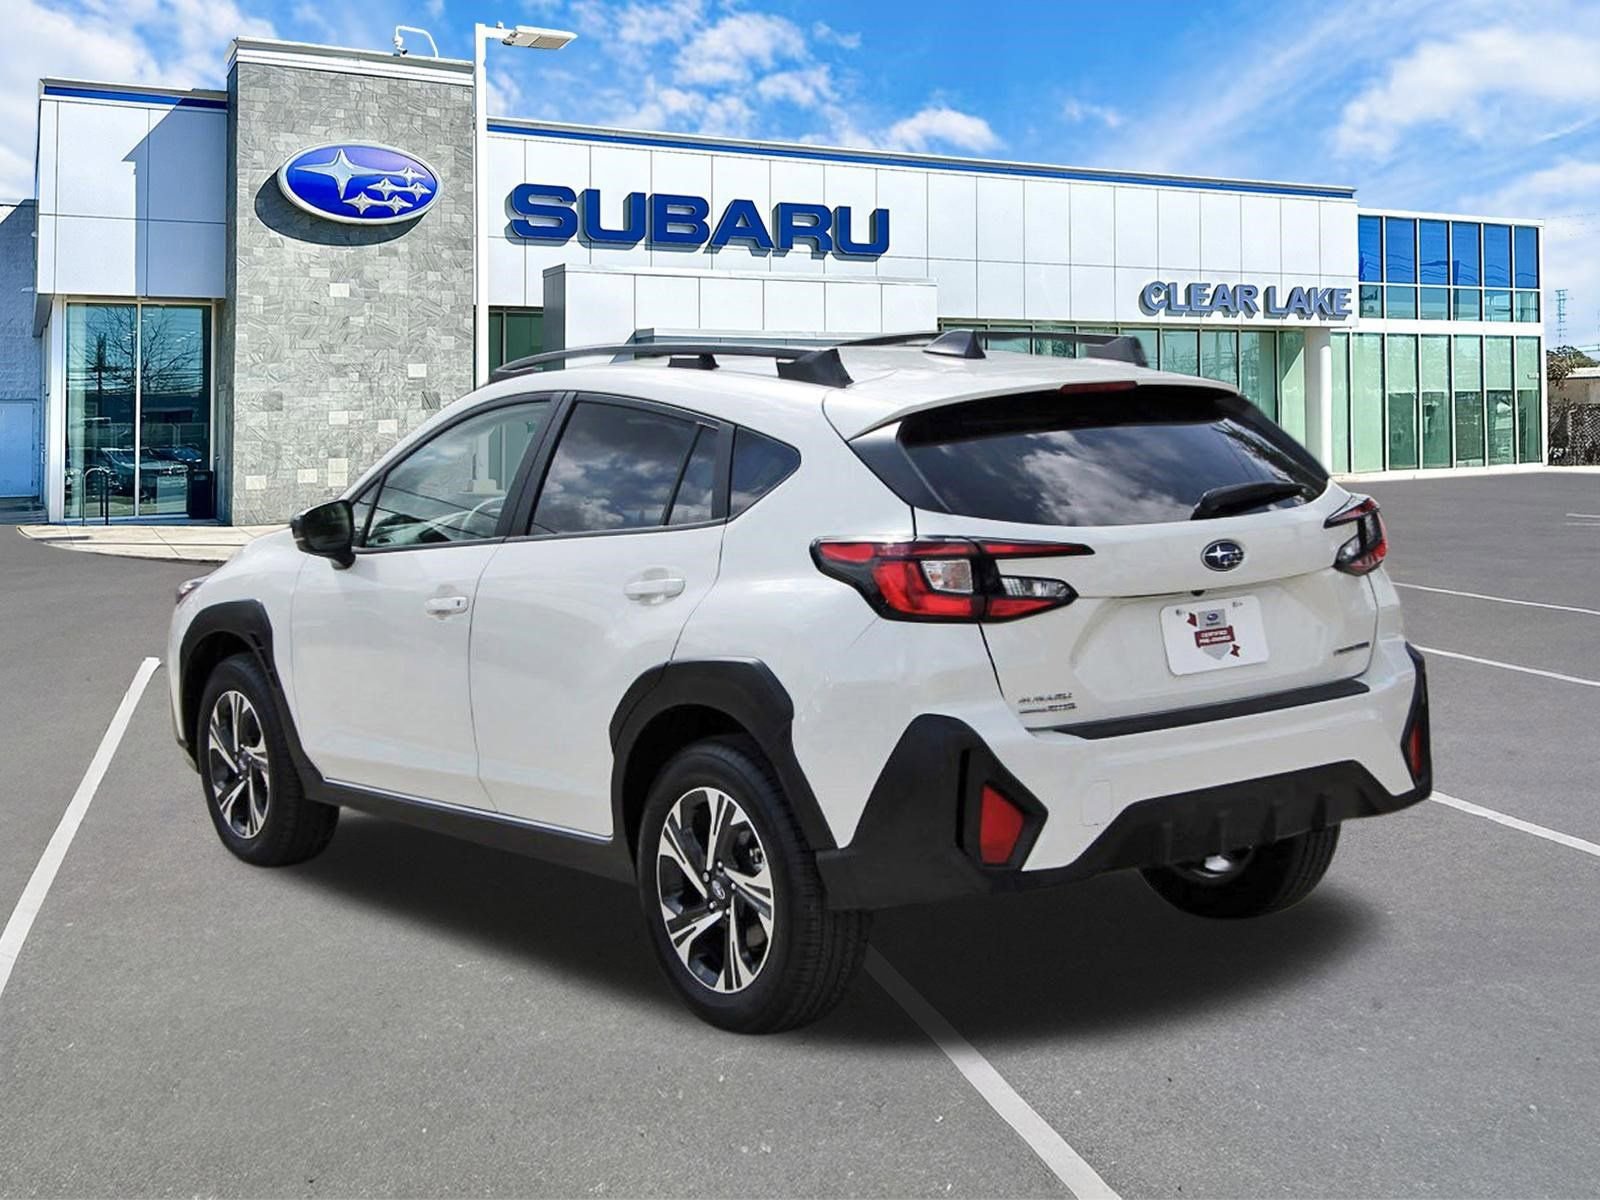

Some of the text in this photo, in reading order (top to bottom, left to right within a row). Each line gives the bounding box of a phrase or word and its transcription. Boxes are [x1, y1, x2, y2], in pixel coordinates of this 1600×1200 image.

[505, 183, 889, 259] SUBARU
[1141, 281, 1352, 320] CLEAR LAKE
